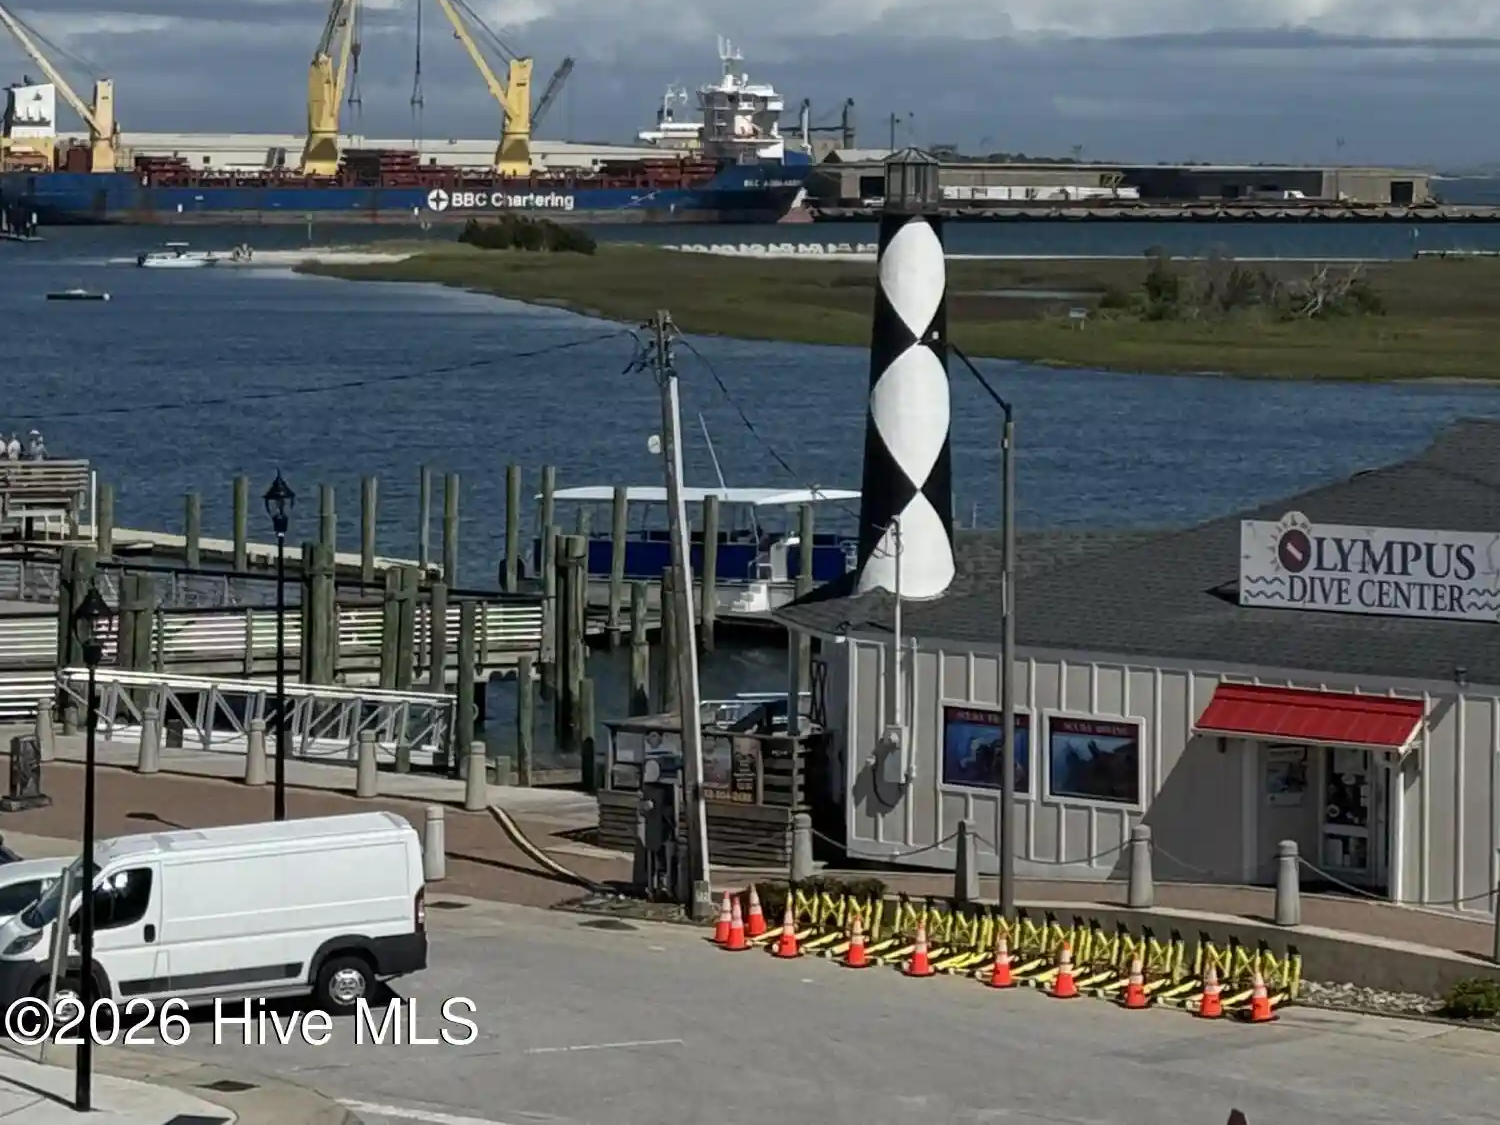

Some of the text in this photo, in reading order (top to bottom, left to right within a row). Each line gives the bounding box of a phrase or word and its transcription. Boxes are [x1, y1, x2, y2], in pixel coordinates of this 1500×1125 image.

[452, 191, 574, 210] BBC Chartering
[1286, 575, 1469, 613] DIVE CENTER
